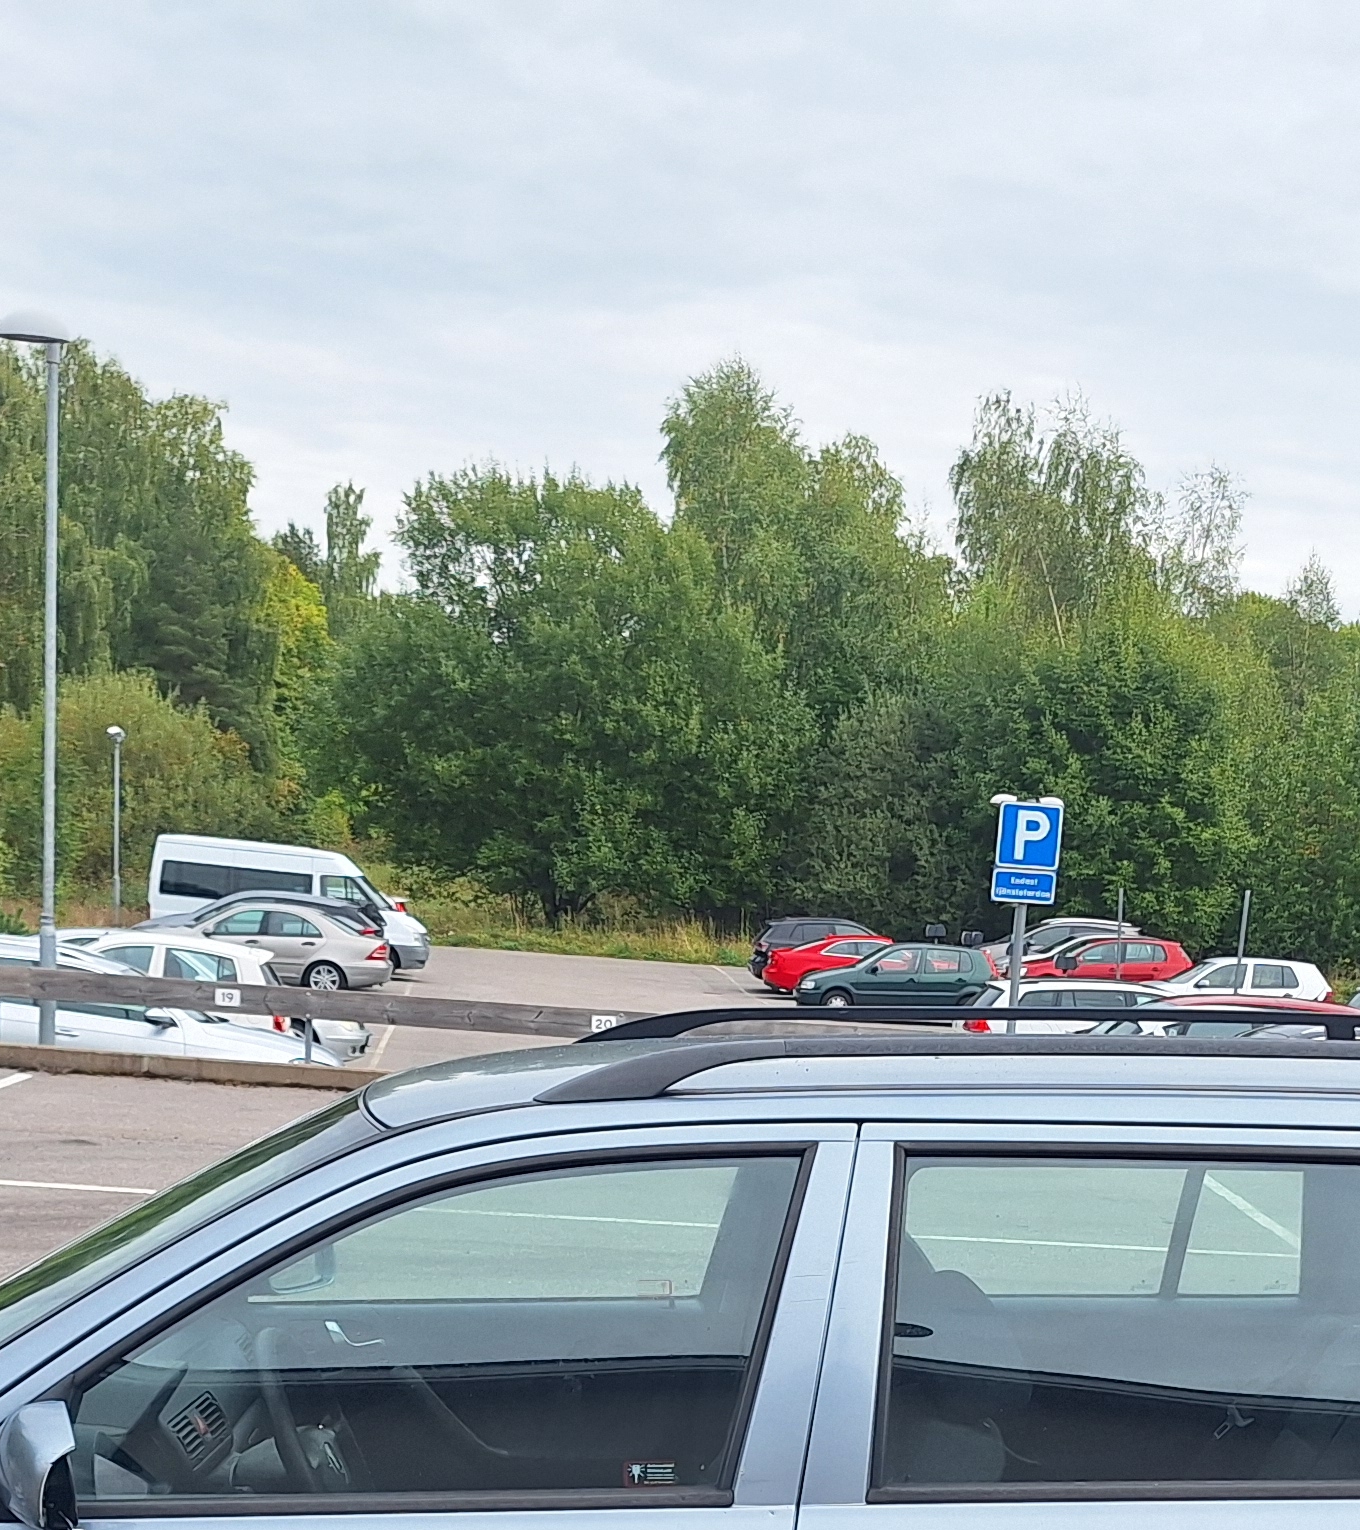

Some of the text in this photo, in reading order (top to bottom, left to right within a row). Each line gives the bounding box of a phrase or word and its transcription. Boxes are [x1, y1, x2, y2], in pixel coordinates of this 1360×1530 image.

[1013, 809, 1051, 860] P
[221, 992, 234, 1003] 19
[595, 1018, 613, 1030] 20
